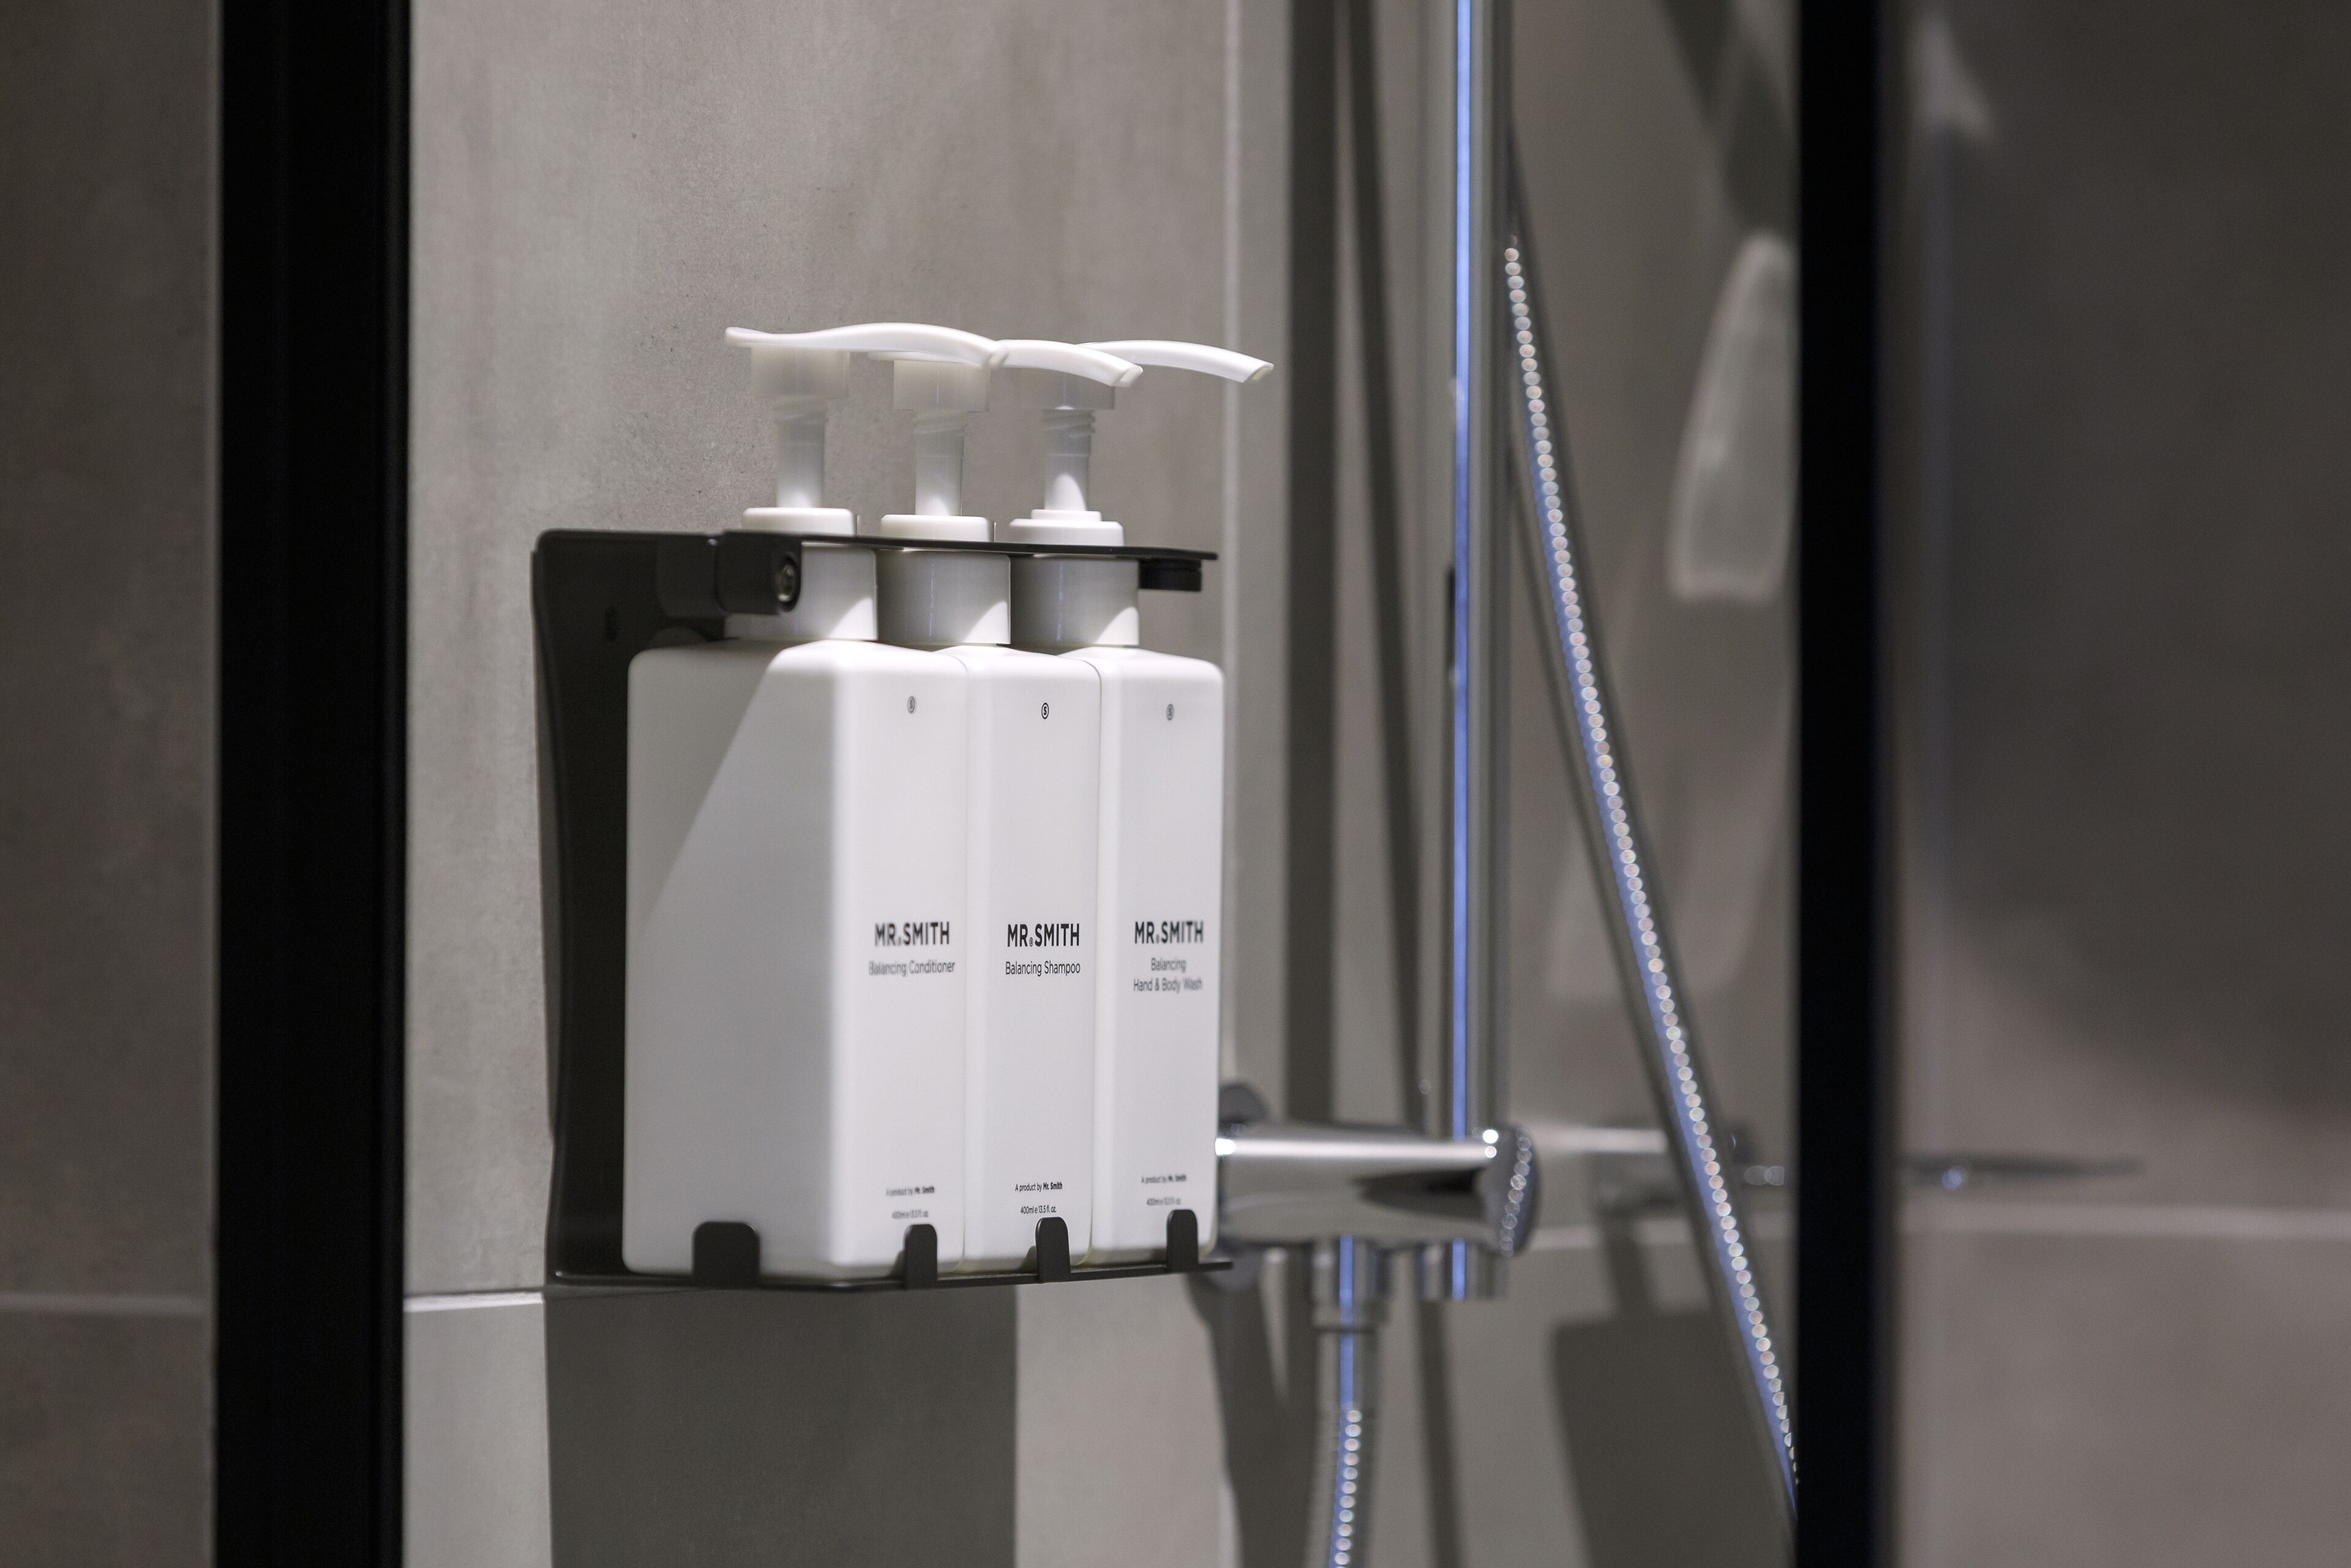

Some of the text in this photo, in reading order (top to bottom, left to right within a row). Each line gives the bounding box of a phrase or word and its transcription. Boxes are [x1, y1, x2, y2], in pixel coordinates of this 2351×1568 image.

[868, 959, 955, 977] Balancing Conditioner
[1005, 960, 1081, 977] Balancing Shampoo
[1150, 957, 1187, 973] Balancing
[1133, 978, 1152, 991] Hand
[1154, 978, 1160, 991] &
[1161, 978, 1180, 994] Body
[1019, 1182, 1036, 1193] product
[1037, 1182, 1043, 1192] by
[1050, 1181, 1063, 1190] Smith
